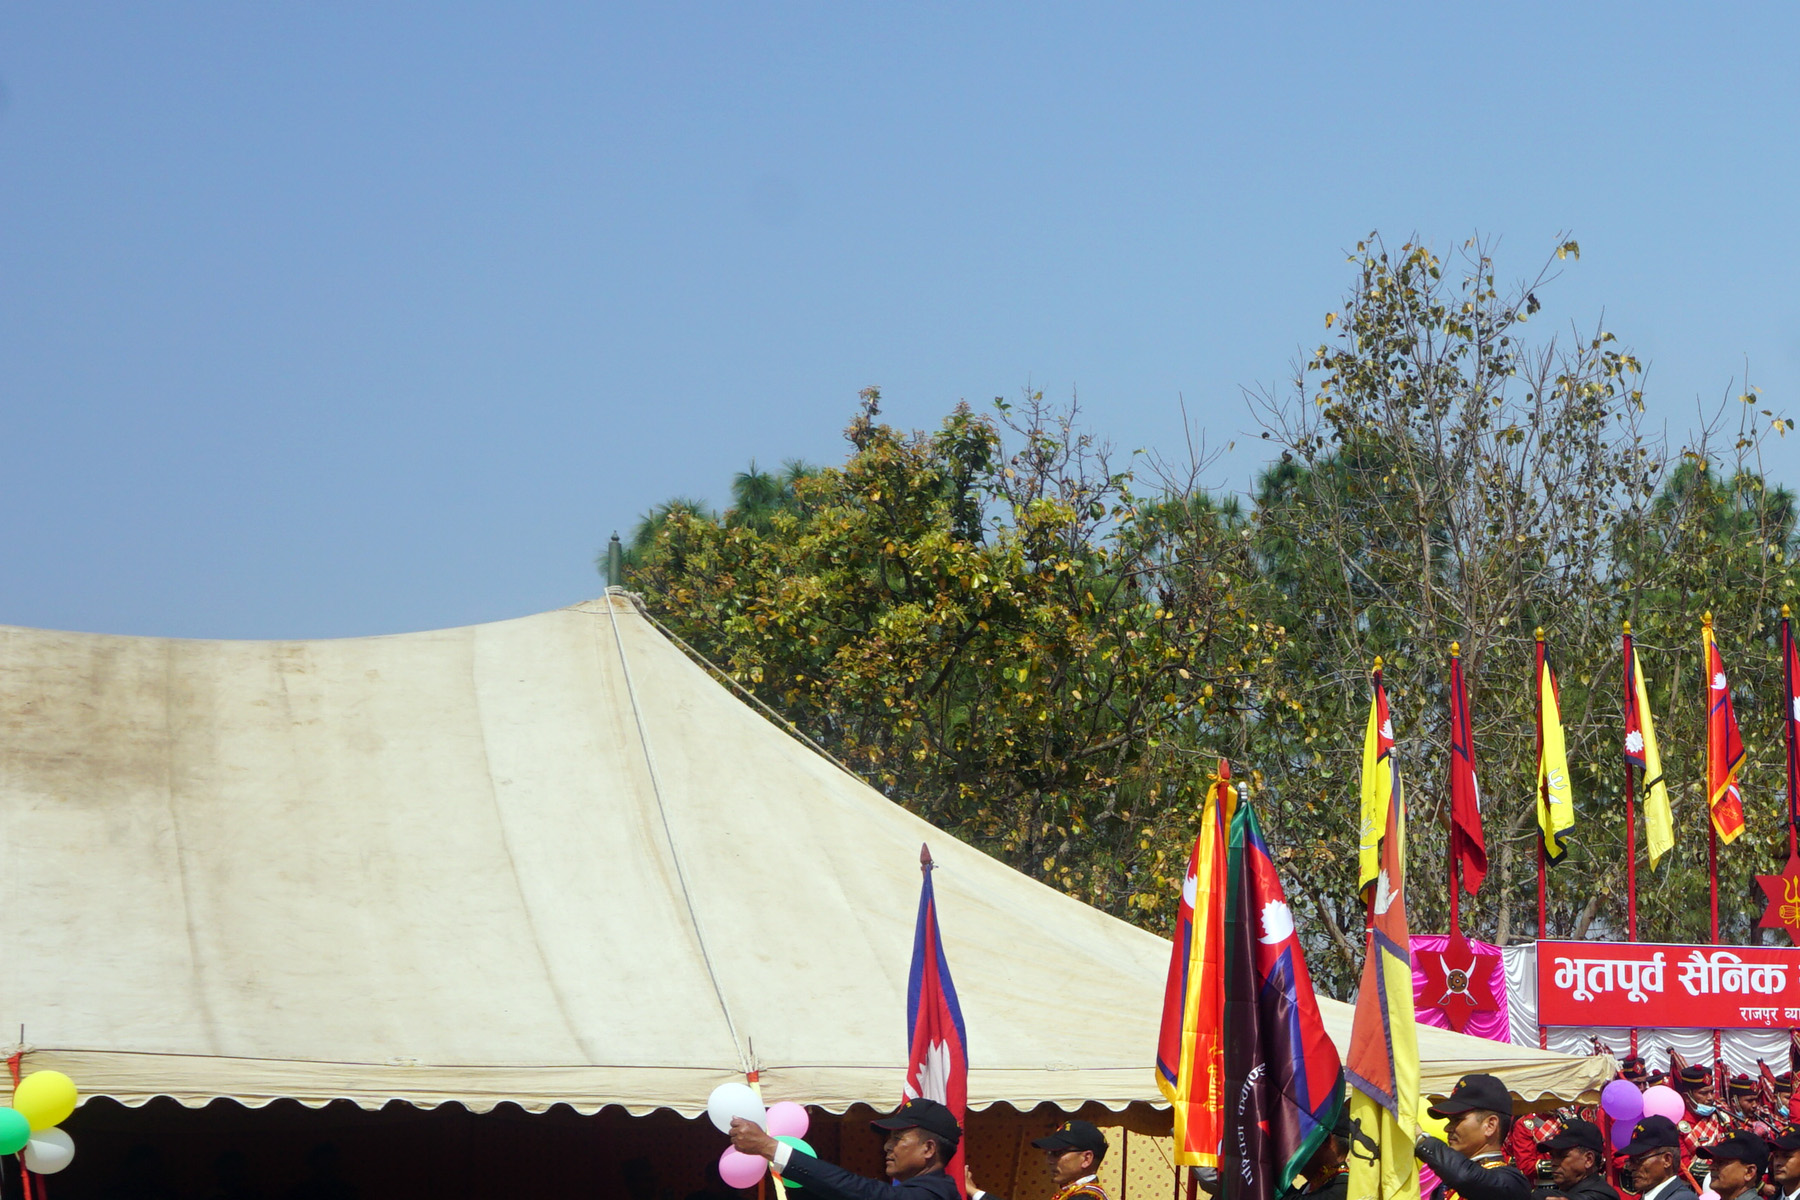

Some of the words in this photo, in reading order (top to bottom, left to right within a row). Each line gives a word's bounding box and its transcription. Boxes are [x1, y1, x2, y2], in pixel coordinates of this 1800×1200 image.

[1554, 952, 1666, 1003] भूतपूर्व
[1678, 950, 1788, 996] सैनिक
[1739, 1006, 1779, 1026] राजपुर
